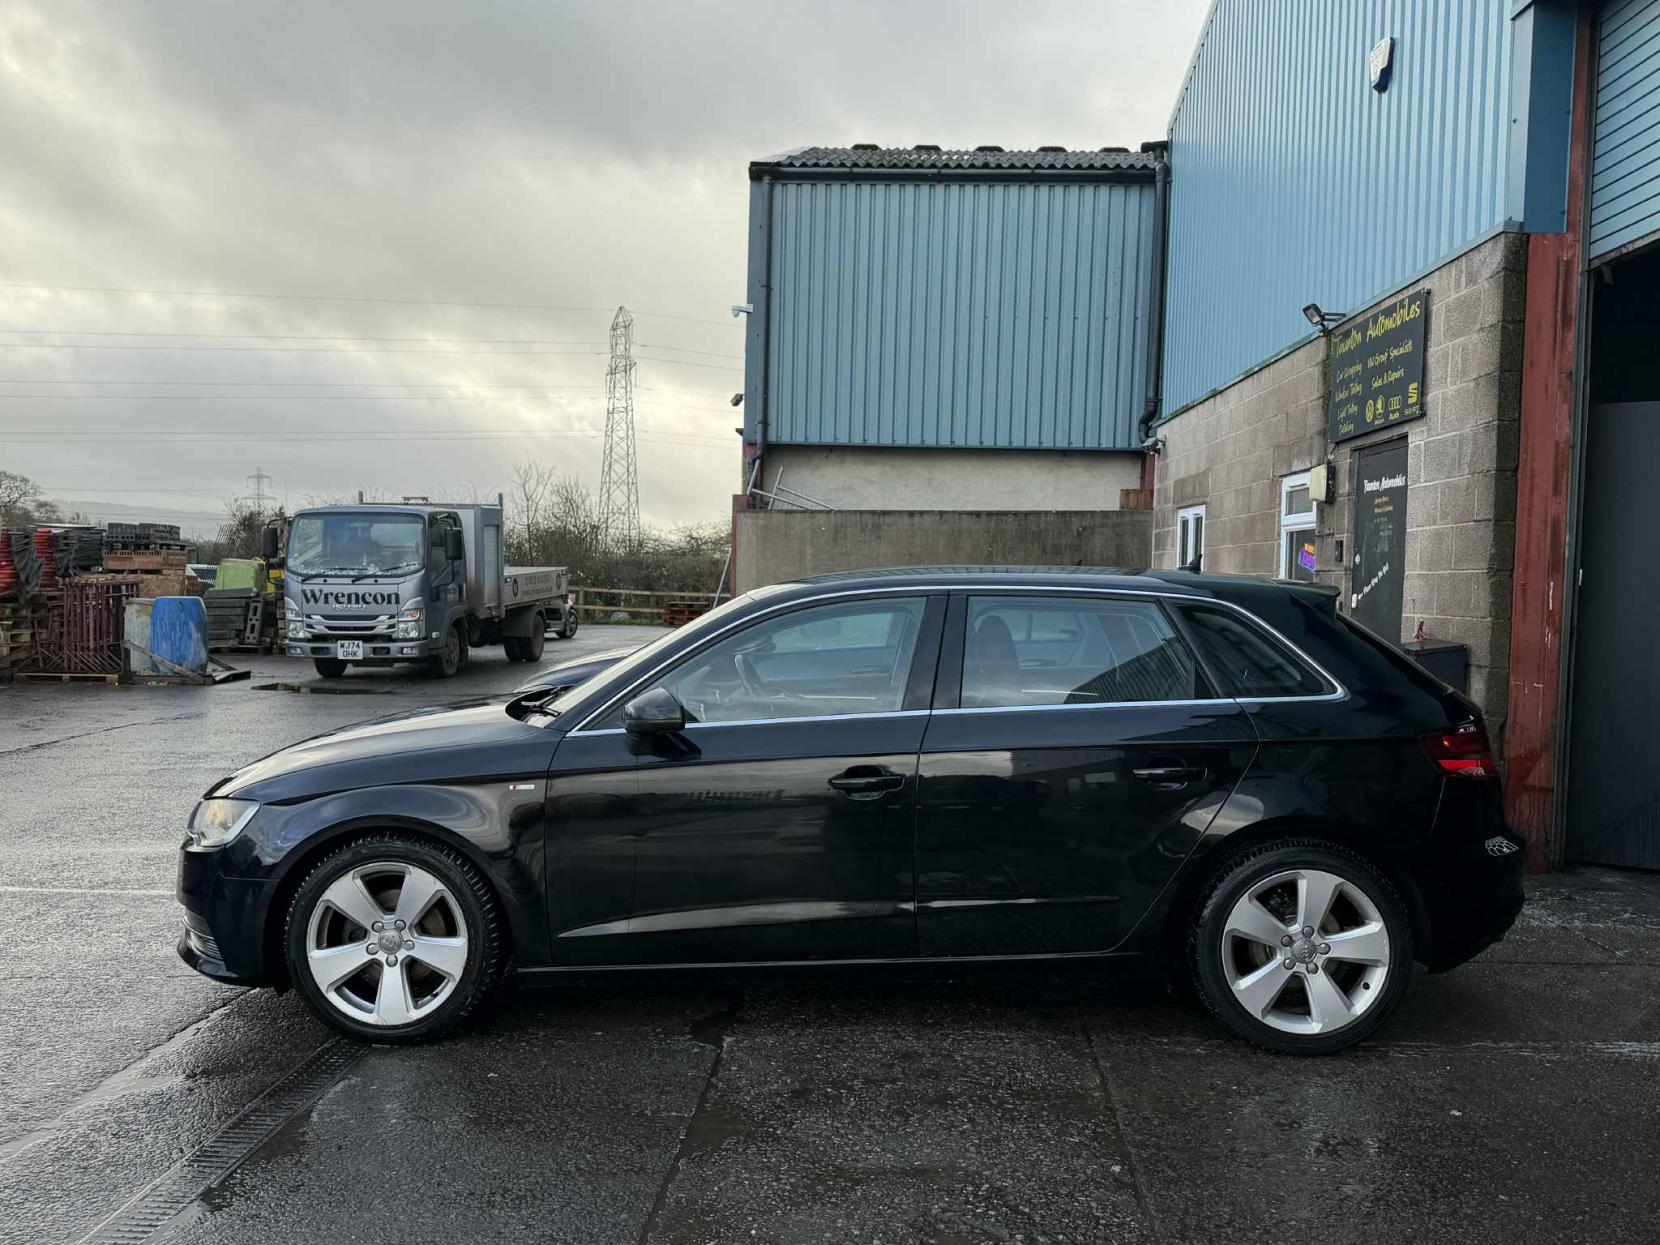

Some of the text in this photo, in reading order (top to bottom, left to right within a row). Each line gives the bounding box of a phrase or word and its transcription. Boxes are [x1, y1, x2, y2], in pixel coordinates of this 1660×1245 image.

[1367, 298, 1420, 342] Automobiles
[1371, 375, 1383, 390] Sales
[301, 588, 400, 605] Wrencon
